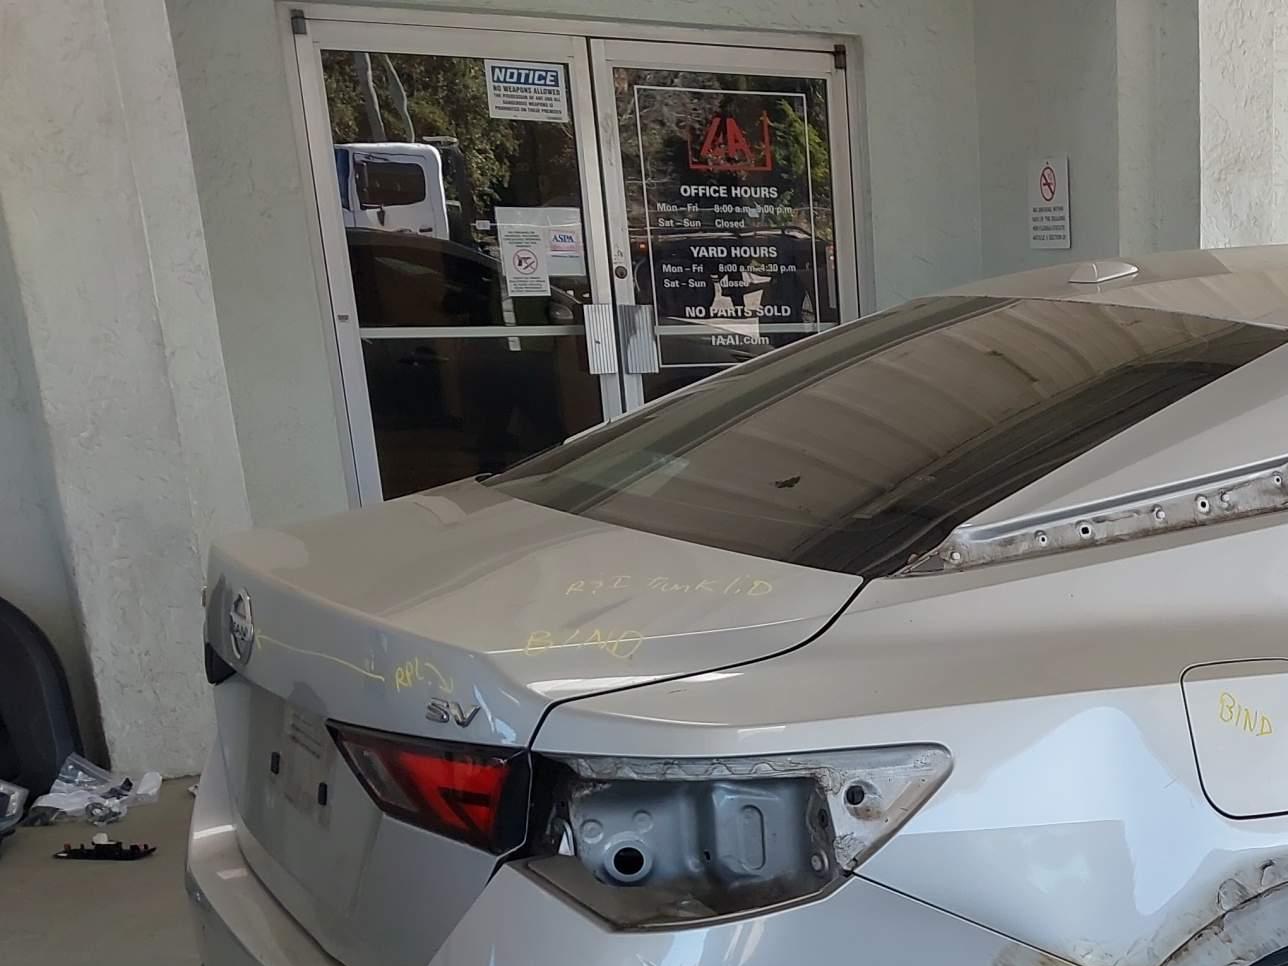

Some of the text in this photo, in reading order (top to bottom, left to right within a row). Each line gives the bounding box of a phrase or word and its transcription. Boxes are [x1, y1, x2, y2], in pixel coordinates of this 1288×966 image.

[493, 67, 557, 85] NOTICE
[502, 85, 532, 94] WEAPONS
[533, 87, 560, 95] ALLOWED
[680, 185, 778, 198] OFFICE HOURS
[657, 203, 678, 212] Mon
[687, 203, 699, 213] Fri
[713, 204, 732, 213] 8:00
[658, 218, 671, 227] Sat
[683, 219, 701, 228] Sun
[715, 219, 745, 228] Closed
[552, 234, 576, 243] ASPA
[690, 246, 777, 258] YARD HOURS
[662, 264, 684, 273] Mon
[692, 264, 704, 273] Fri
[718, 264, 737, 273] 8:00
[663, 279, 680, 288] Sat
[688, 279, 707, 288] Sun
[720, 278, 750, 288] Closed
[685, 305, 791, 318] NO PARTS SOLD
[711, 335, 770, 347] IAAI.com
[425, 697, 481, 728] SV
[1219, 692, 1273, 737] BIND
